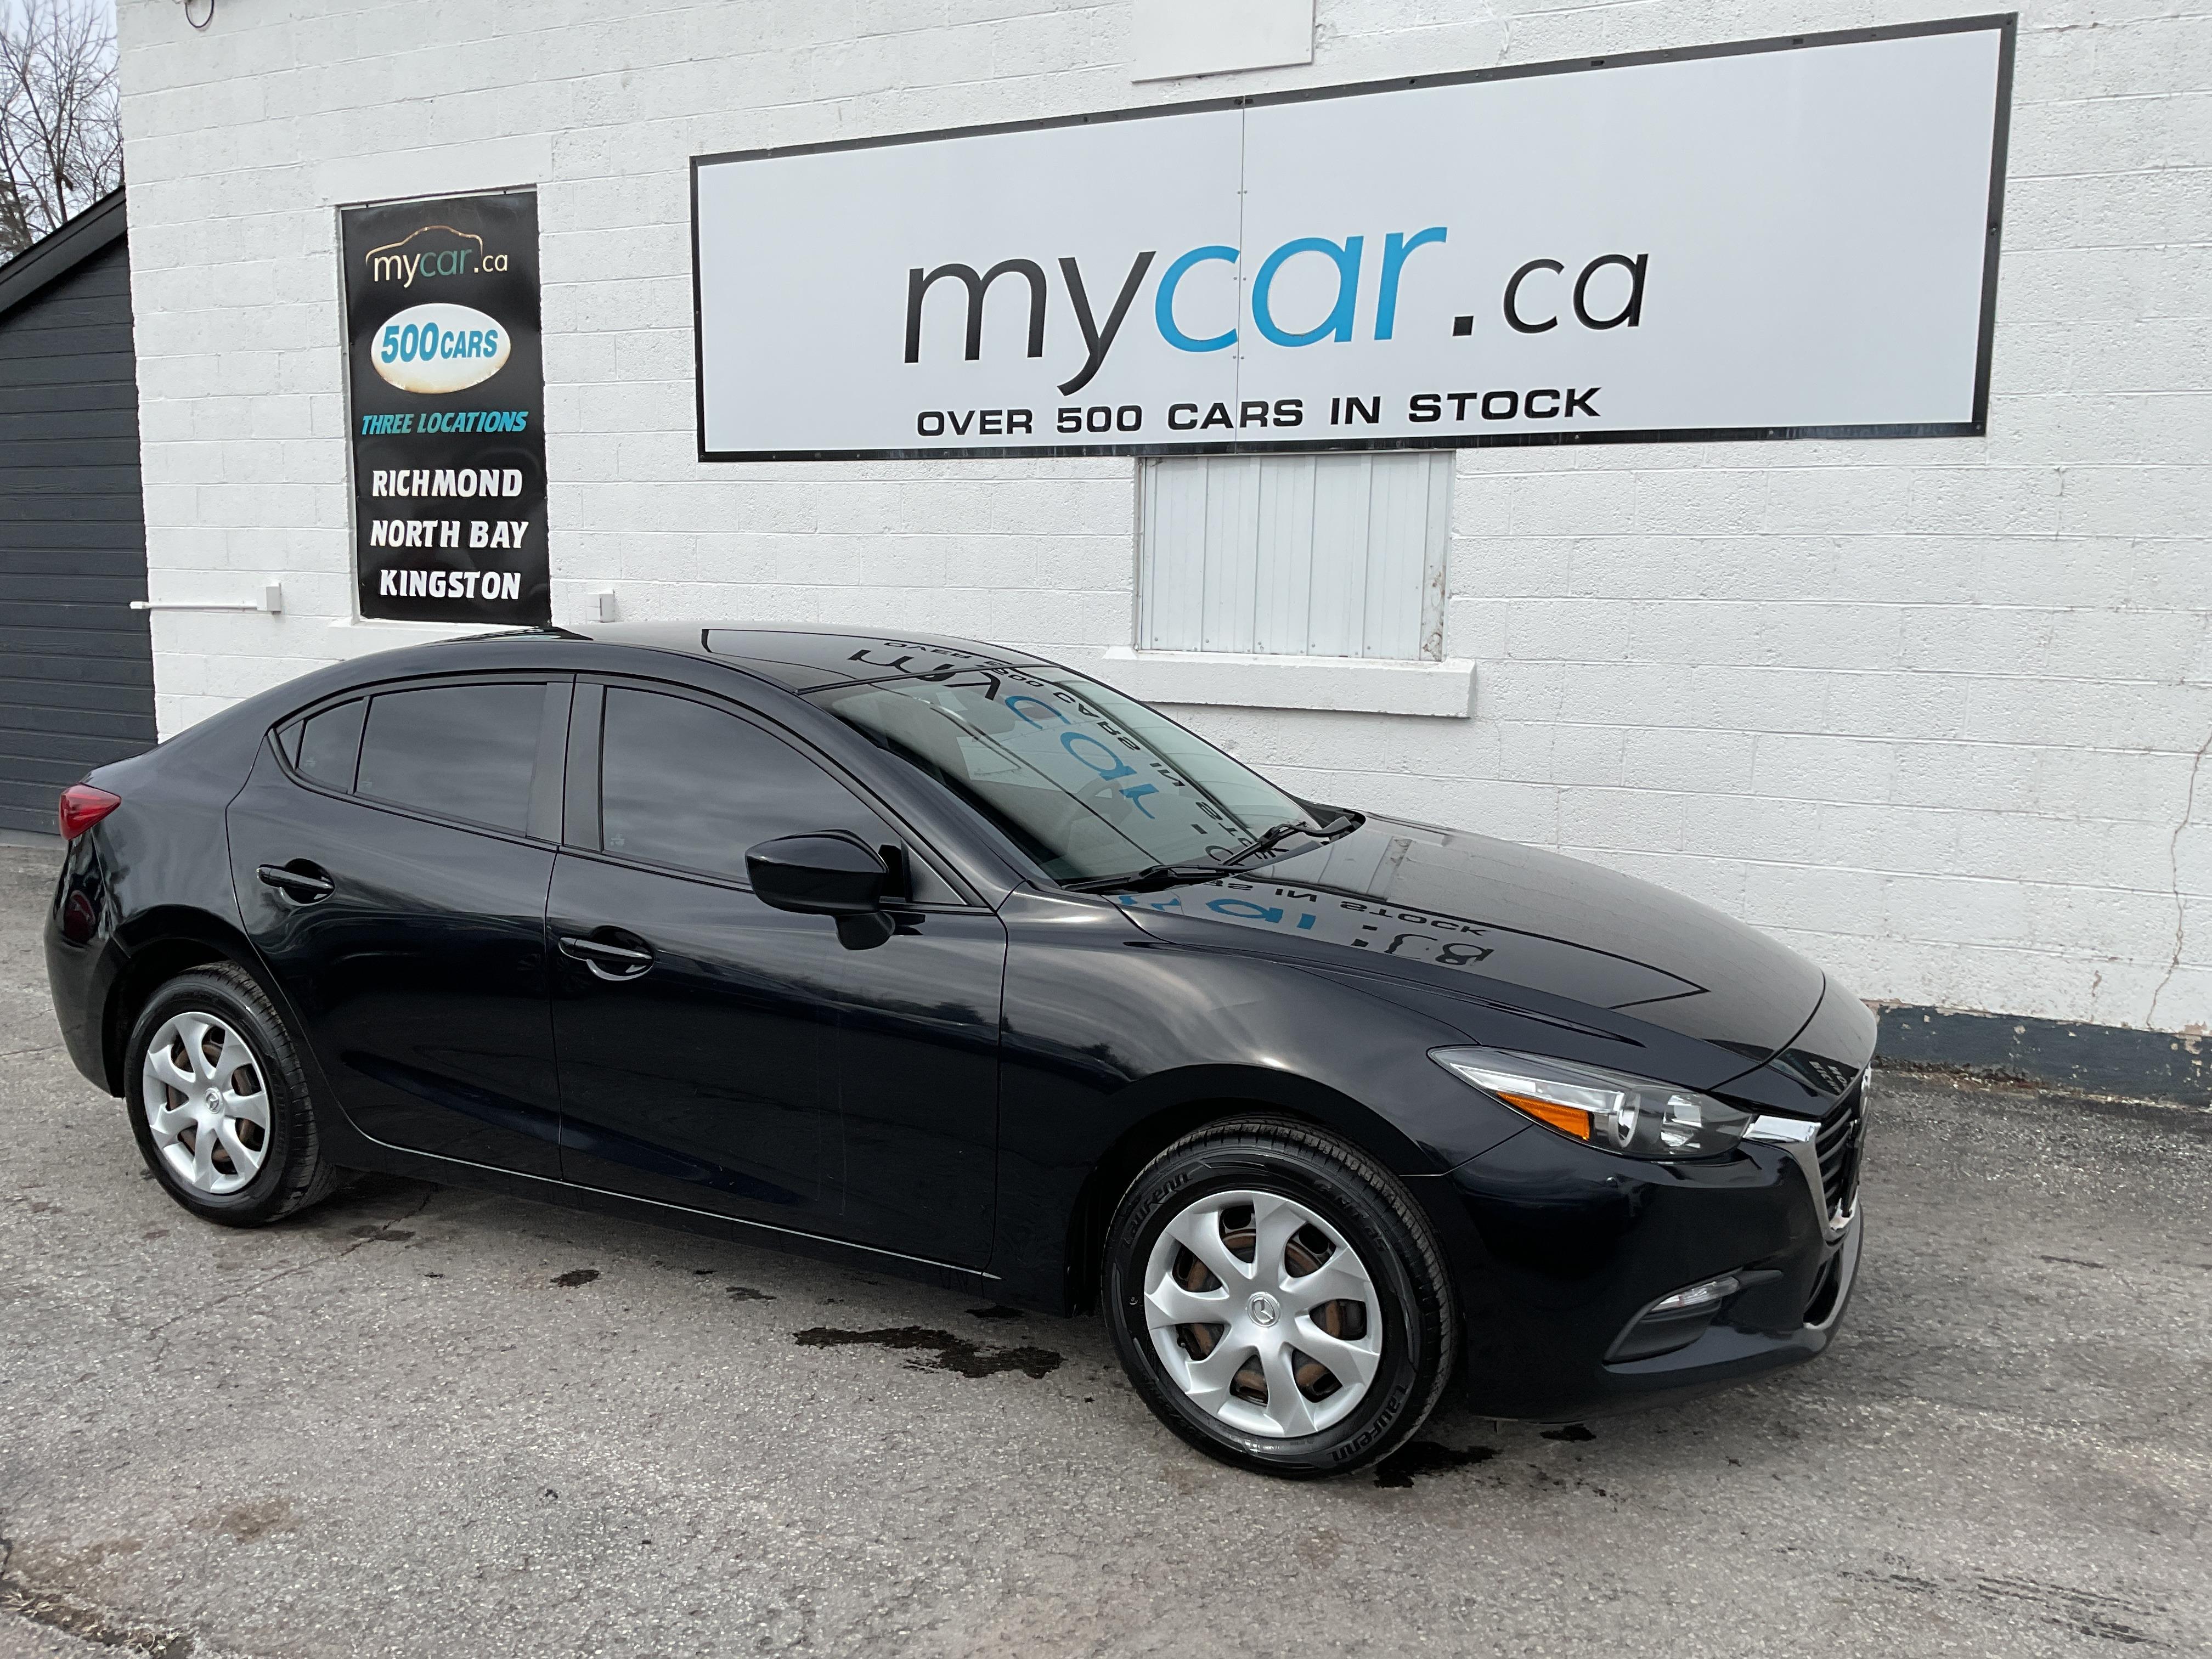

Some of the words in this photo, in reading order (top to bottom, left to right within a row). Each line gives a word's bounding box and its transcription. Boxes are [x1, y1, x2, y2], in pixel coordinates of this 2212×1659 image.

[373, 248, 508, 289] mycar.ca
[904, 226, 1649, 397] mycar.ca
[362, 413, 415, 435] THREE
[417, 411, 529, 434] LOCATIONS
[917, 409, 1033, 436] OVER
[1057, 405, 1142, 433] 500
[1167, 399, 1303, 430] CARS
[1330, 396, 1381, 425] IN
[1408, 387, 1602, 422] STOCK
[372, 469, 523, 498] RICHMOND
[370, 520, 460, 548] NORTH
[469, 521, 529, 549] BAY
[380, 569, 521, 600] KINGSTON
